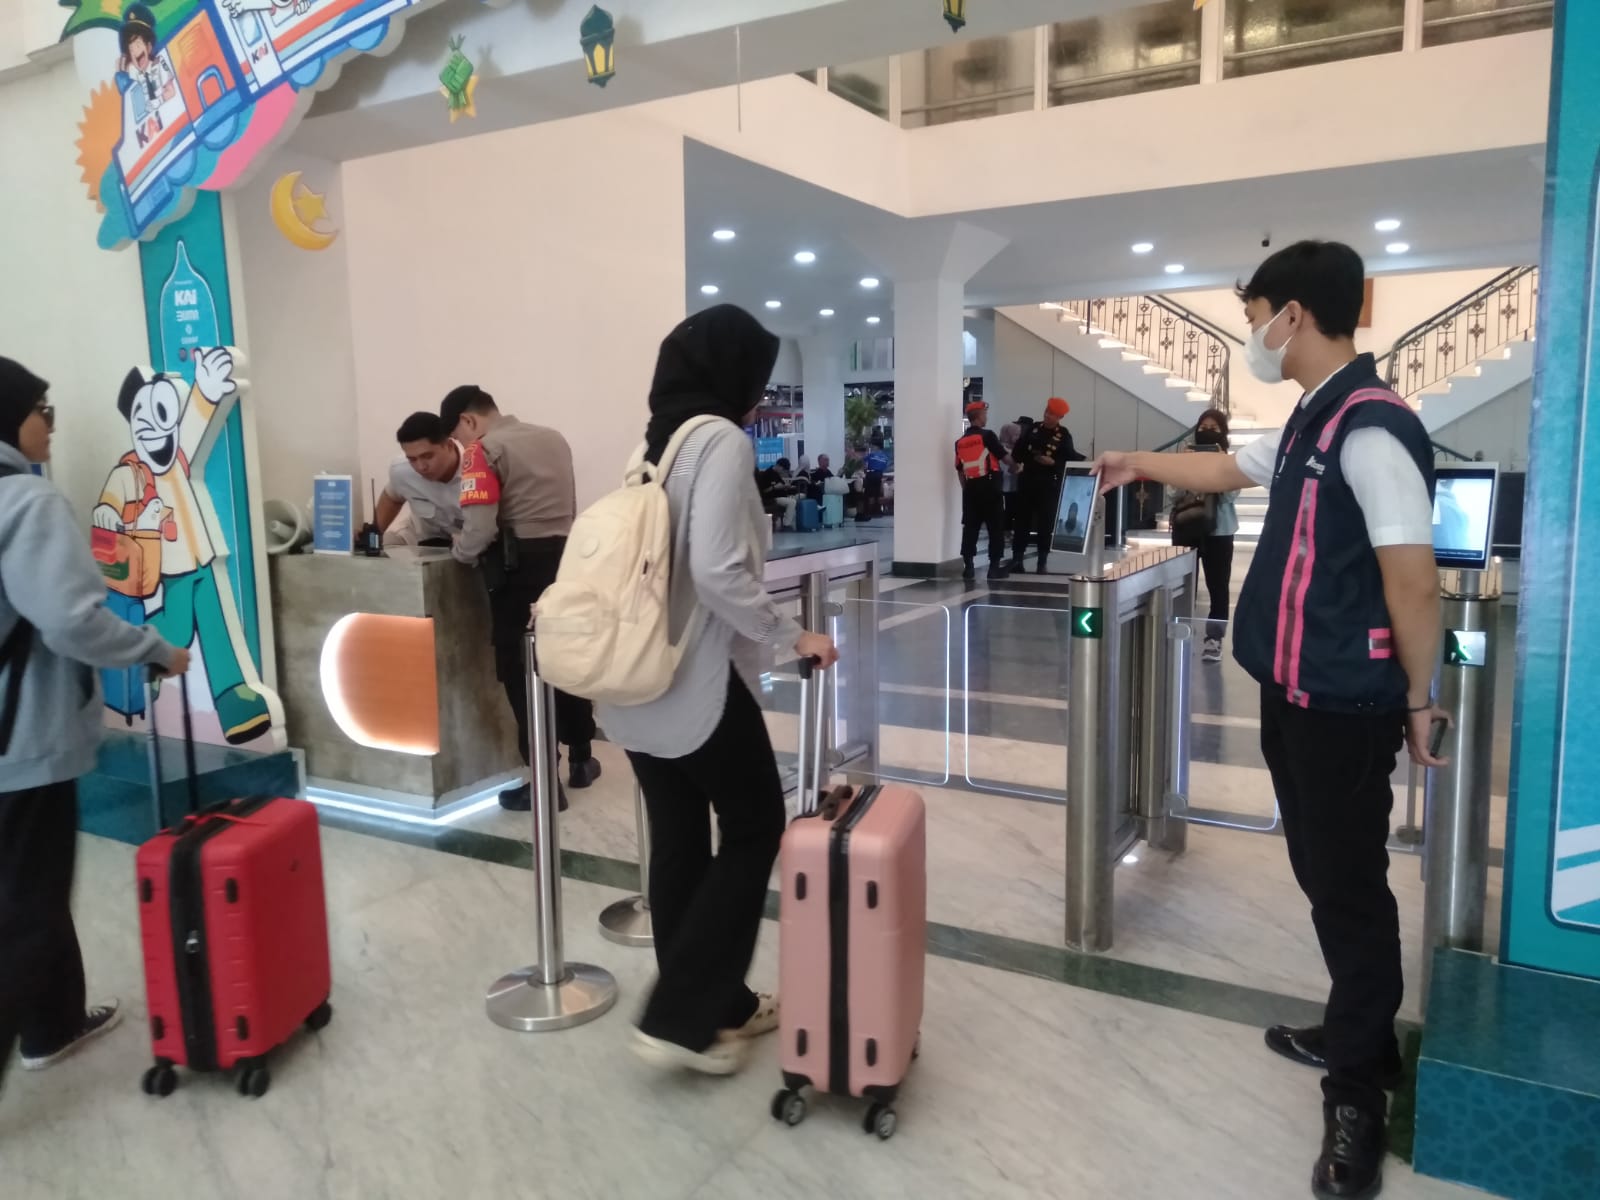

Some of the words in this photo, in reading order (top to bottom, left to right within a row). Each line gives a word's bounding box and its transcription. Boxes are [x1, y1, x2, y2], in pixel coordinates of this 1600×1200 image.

[251, 42, 269, 65] KAI
[135, 110, 164, 149] KAI
[174, 289, 198, 307] KAI
